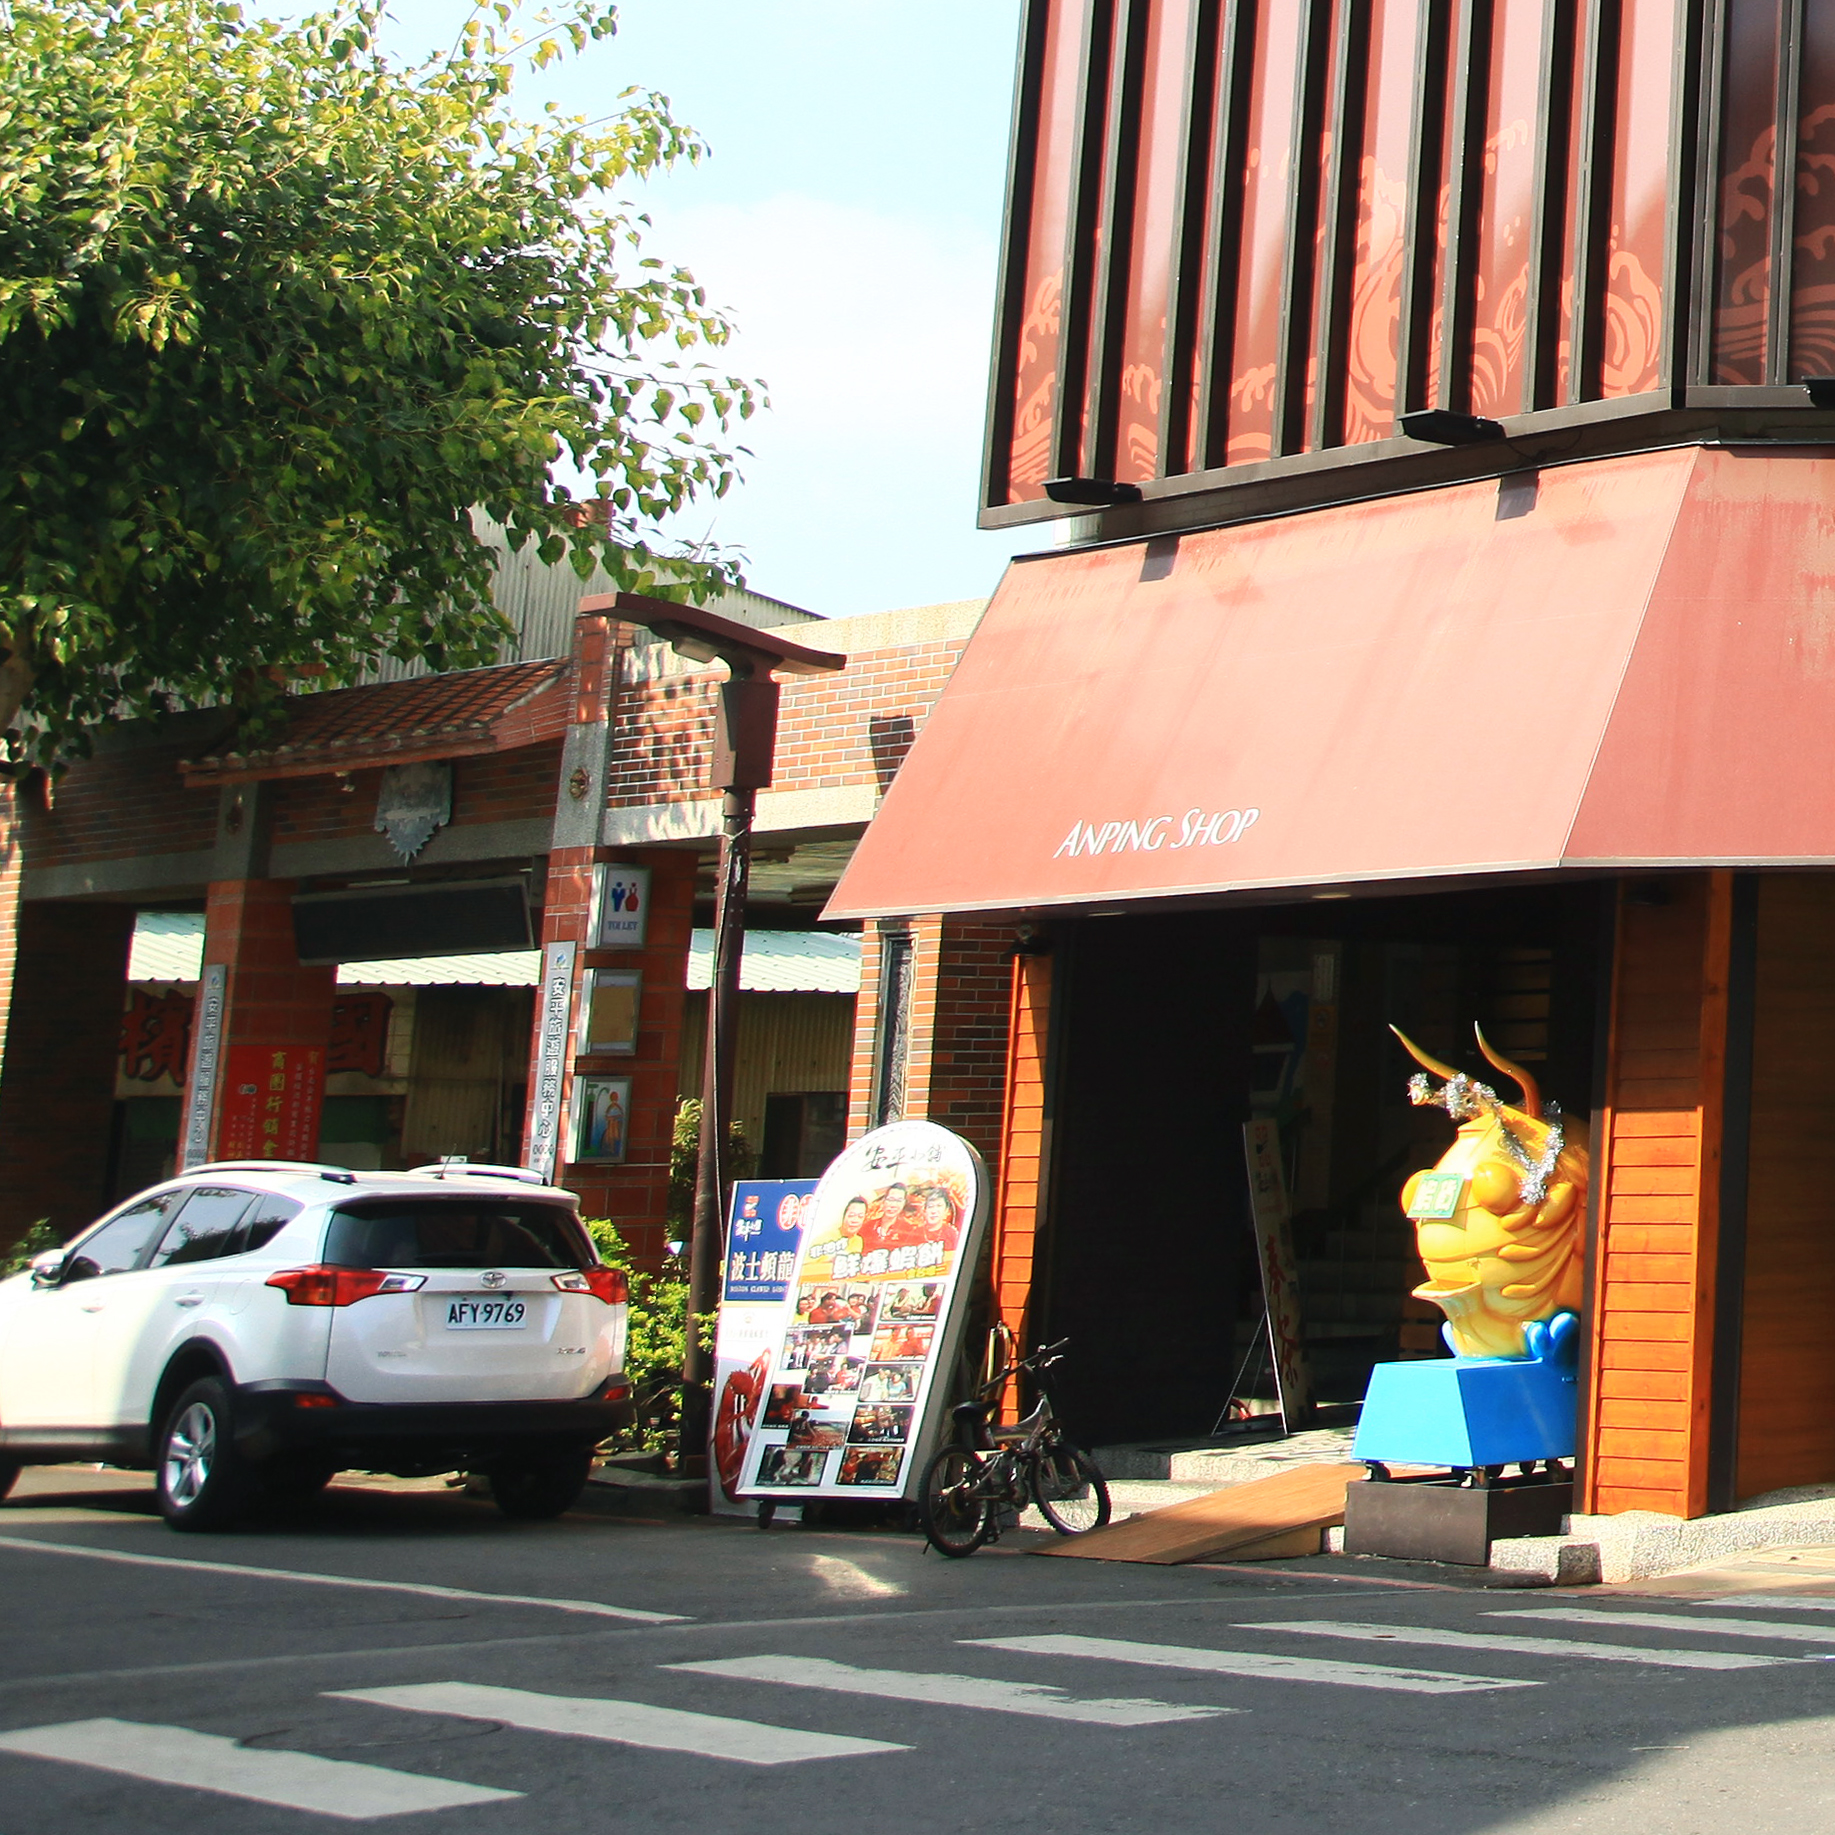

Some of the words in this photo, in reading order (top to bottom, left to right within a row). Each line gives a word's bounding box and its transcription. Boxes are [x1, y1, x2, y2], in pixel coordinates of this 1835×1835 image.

[1052, 816, 1174, 859] ANPING
[1170, 807, 1261, 849] SHOP
[607, 920, 639, 932] TOILET
[730, 1251, 796, 1282] 波士頓龍
[448, 1302, 526, 1324] AFY-9769
